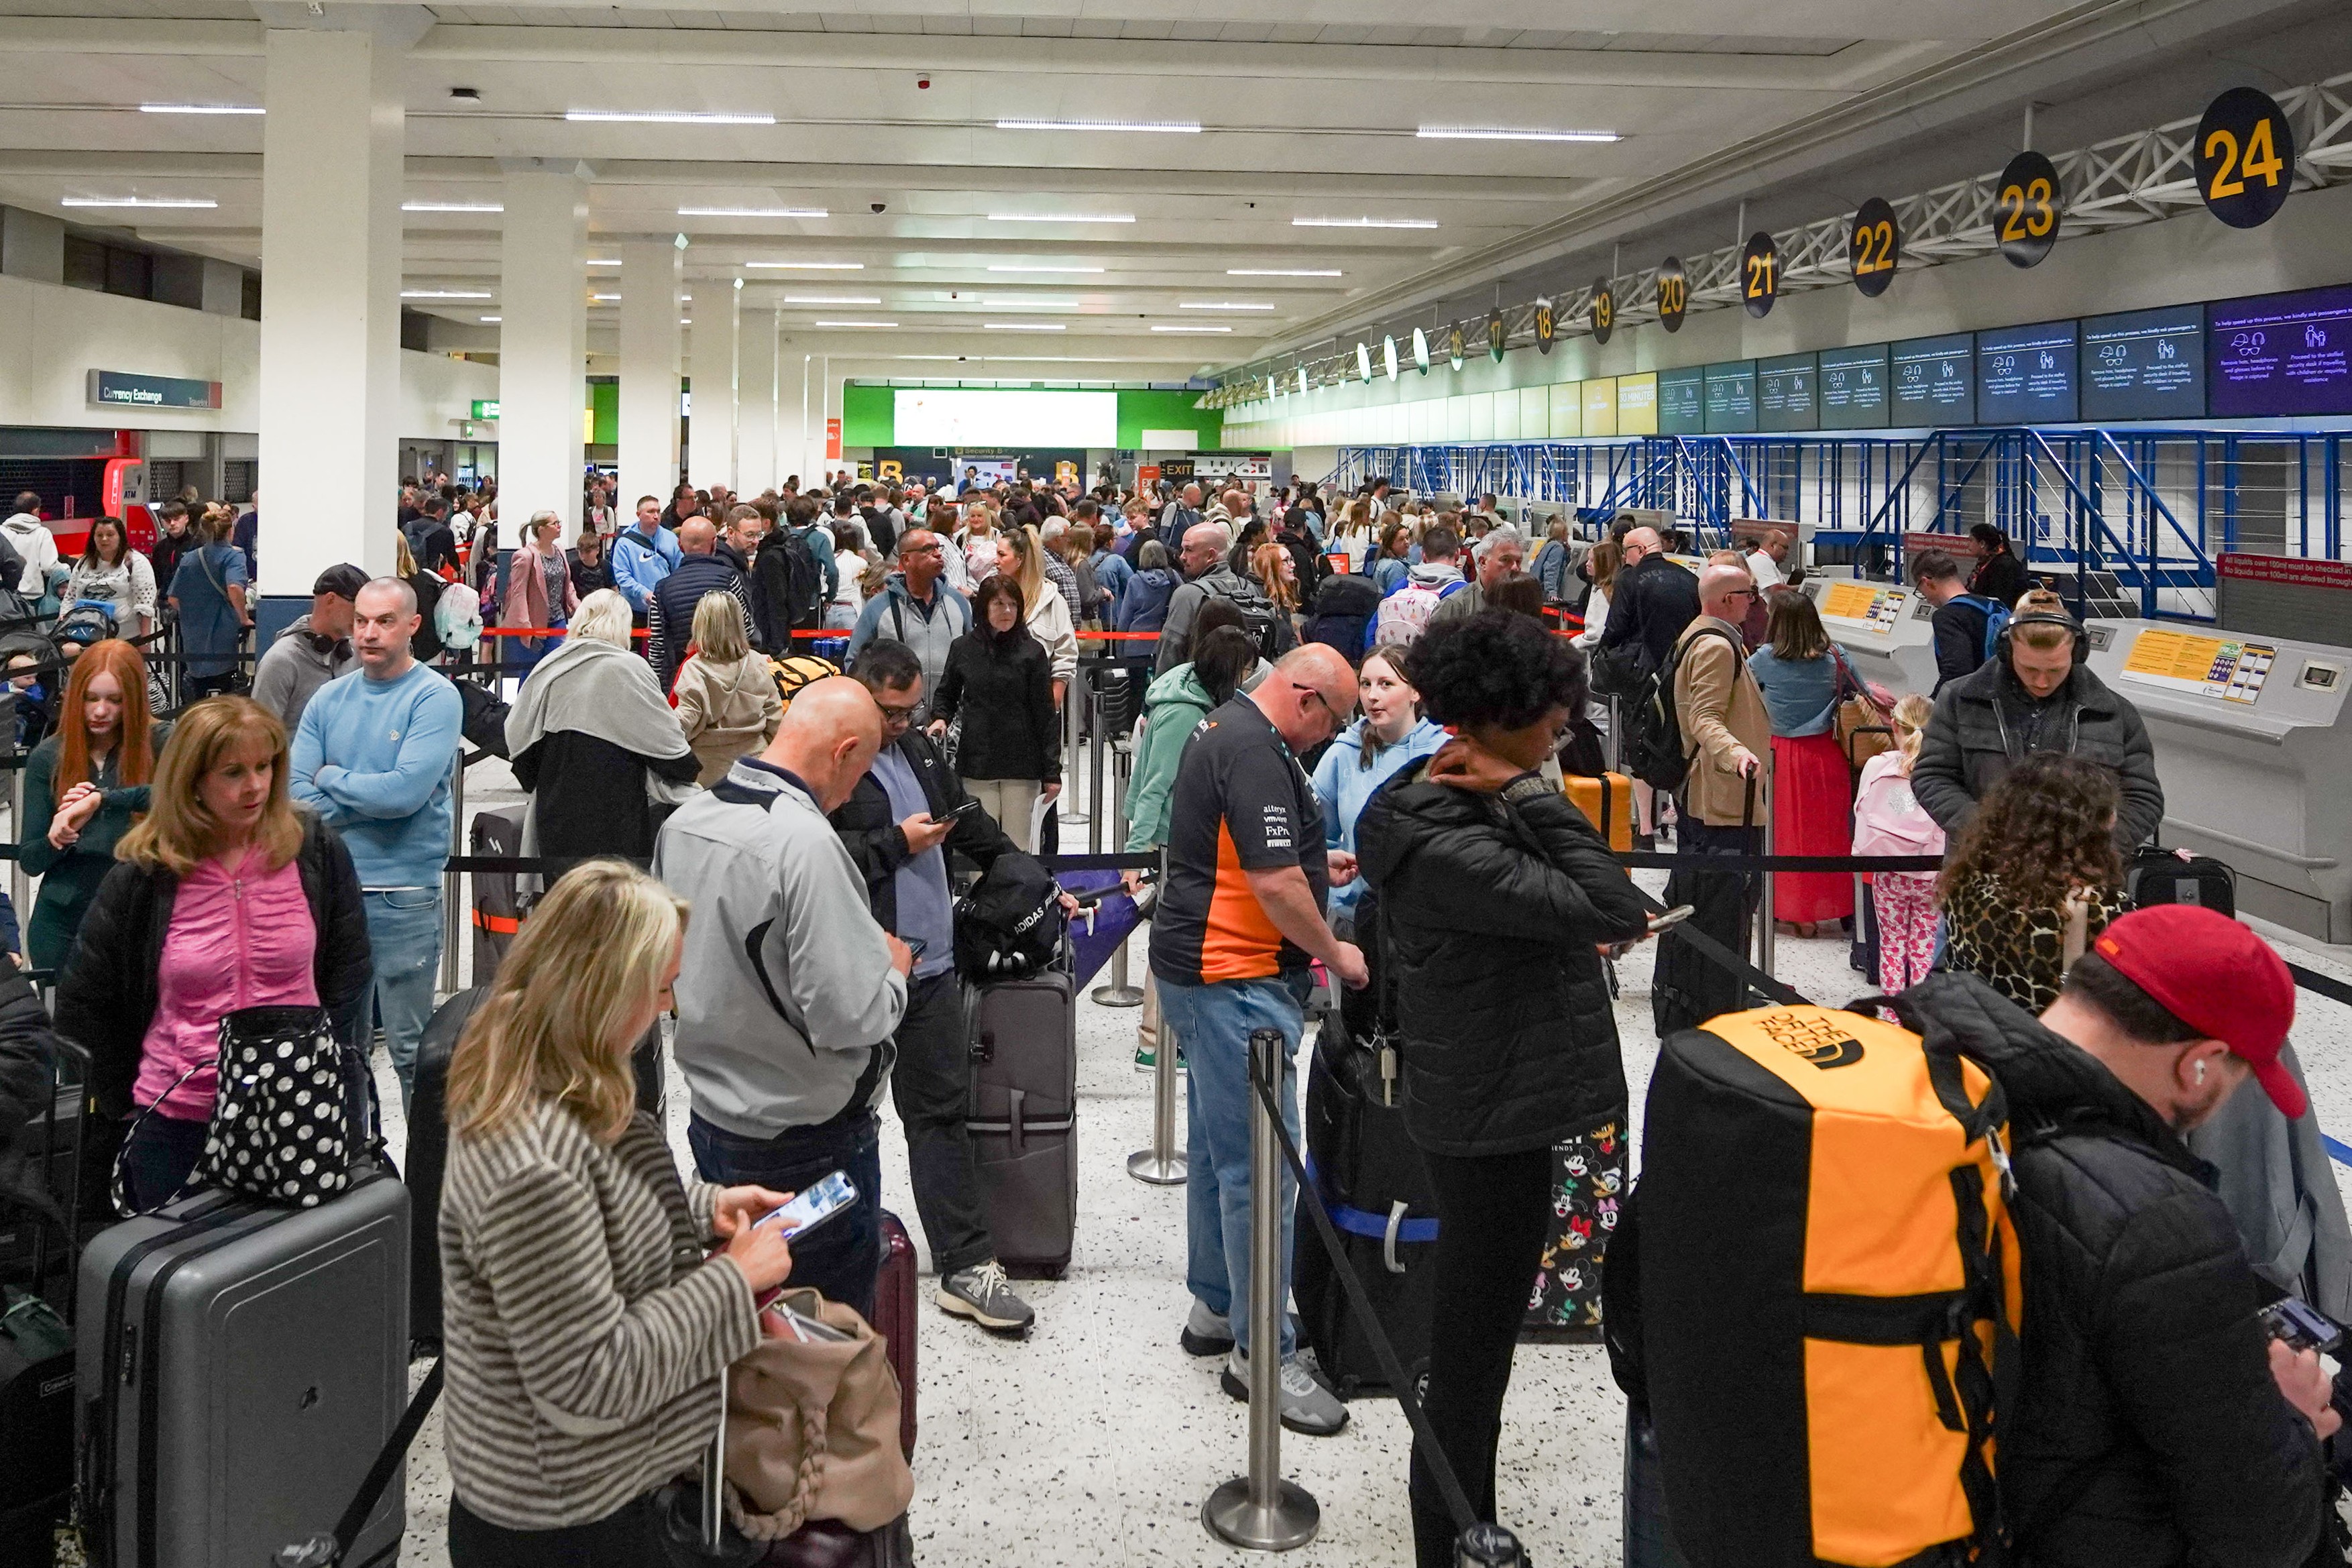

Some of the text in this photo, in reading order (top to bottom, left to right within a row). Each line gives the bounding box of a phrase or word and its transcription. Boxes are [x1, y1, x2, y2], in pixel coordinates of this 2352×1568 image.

[2205, 118, 2282, 200] 24
[2001, 178, 2053, 242] 23
[1856, 221, 1893, 274] 22
[1748, 251, 1773, 298] 21
[1659, 275, 1684, 315] 20
[1537, 308, 1552, 339] 18
[1595, 292, 1610, 328] 19
[1451, 330, 1462, 357] 16
[1490, 321, 1500, 349] 17
[103, 386, 162, 404] Currency Exchange
[1628, 390, 1655, 402] MINUTES
[880, 460, 903, 484] B
[1056, 462, 1079, 486] B
[1167, 465, 1192, 475] EXIT
[123, 490, 136, 499] ATM
[2234, 557, 2253, 566] liquids
[2269, 560, 2288, 568] 100ml
[2305, 563, 2314, 571] be
[2314, 565, 2343, 574] checked
[2344, 567, 2351, 575] in
[2234, 567, 2253, 576] liquids
[2270, 570, 2288, 579] 100ml
[2300, 574, 2325, 583] allowed
[1263, 804, 1286, 815] alteryx
[1014, 907, 1044, 935] ADIDAS
[1752, 1019, 1808, 1052] FACE
[1771, 1013, 1830, 1048] ORTH
[1805, 1016, 1853, 1043] THE
